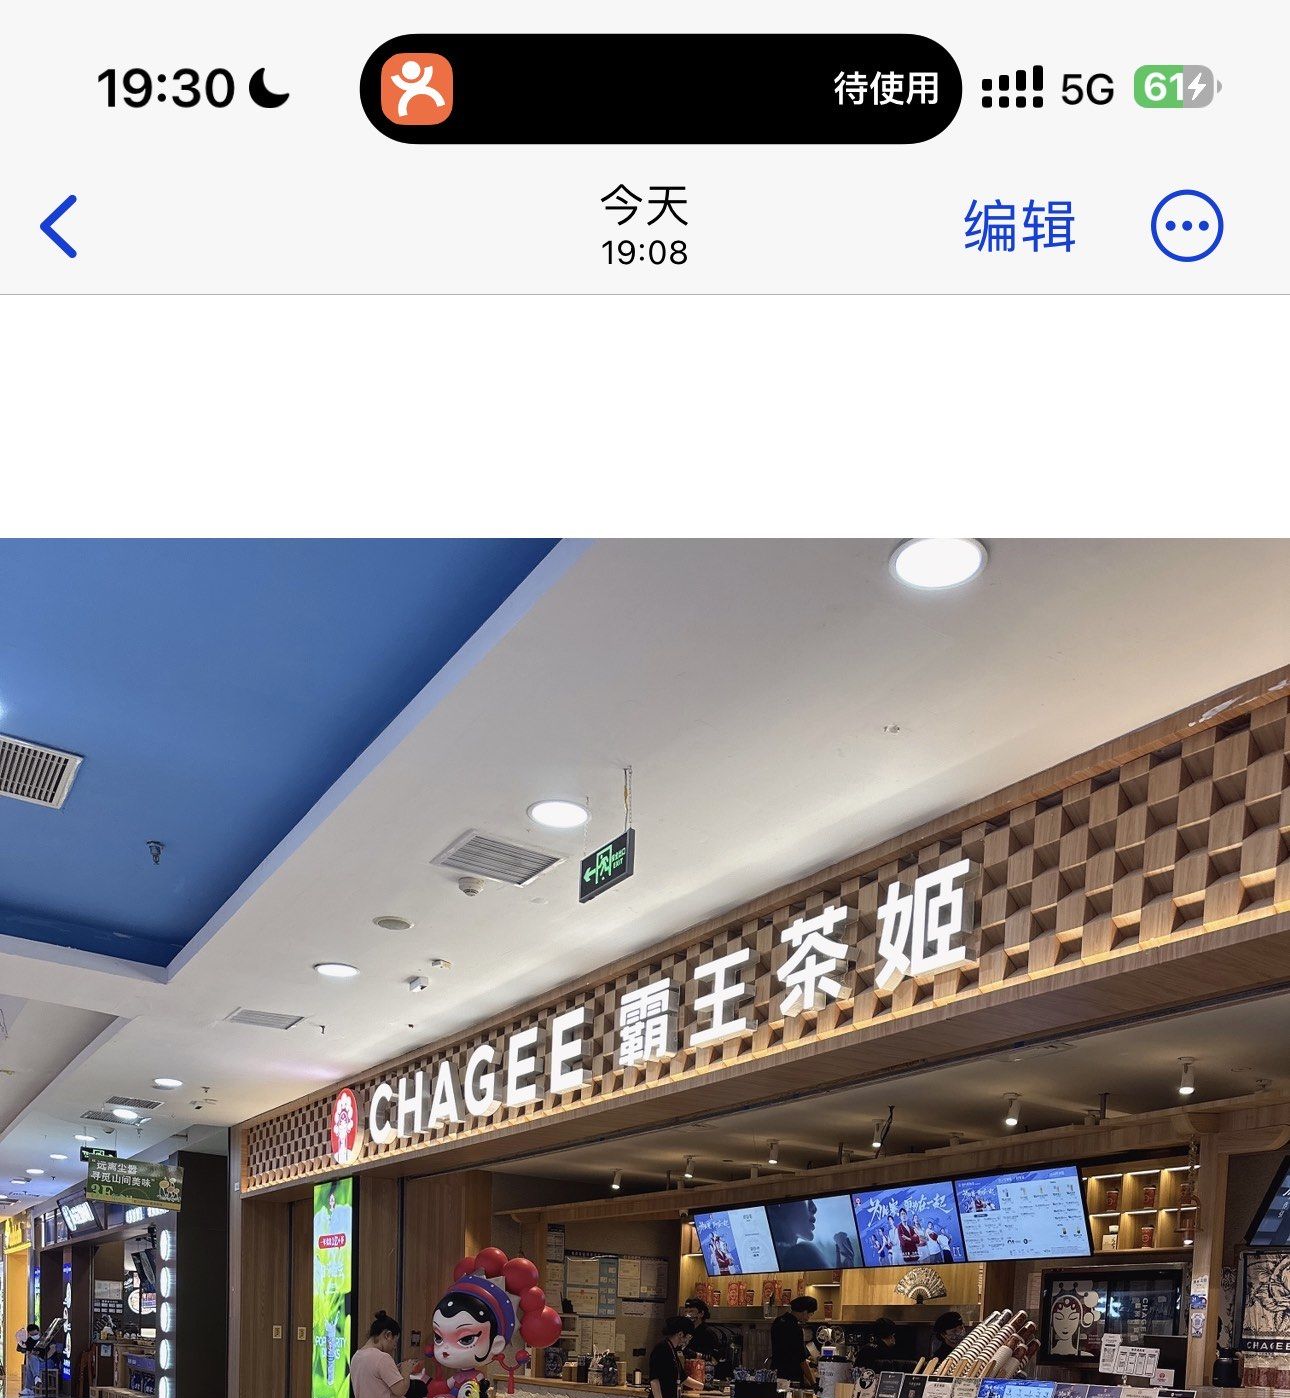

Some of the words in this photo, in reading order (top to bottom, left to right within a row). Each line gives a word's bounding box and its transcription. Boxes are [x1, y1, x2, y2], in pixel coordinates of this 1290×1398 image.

[98, 68, 235, 108] 19:30
[833, 71, 939, 106] 待使用
[1061, 73, 1115, 106] 5G
[1144, 72, 1184, 102] 61
[600, 183, 688, 226] 今天
[964, 199, 1075, 252] 编辑
[602, 240, 687, 265] 19:08
[367, 1005, 590, 1146] CHAGEE
[618, 857, 975, 1068] 霸王茶姬
